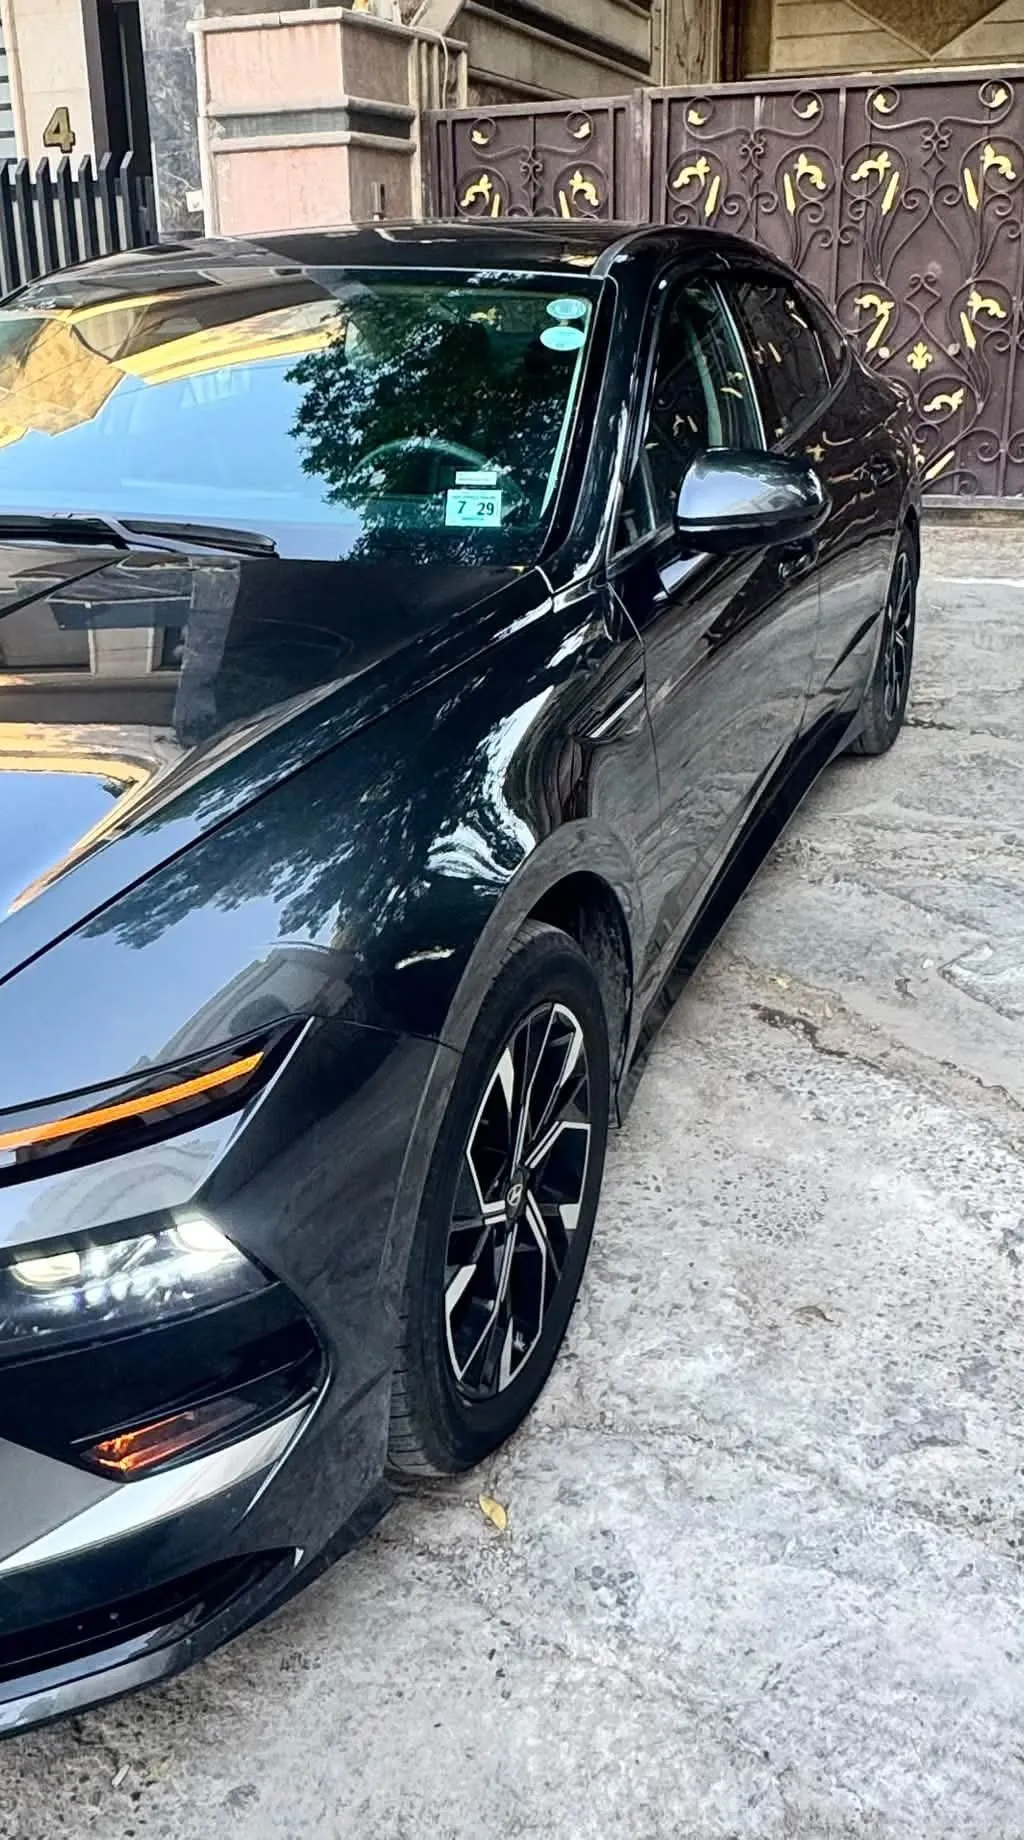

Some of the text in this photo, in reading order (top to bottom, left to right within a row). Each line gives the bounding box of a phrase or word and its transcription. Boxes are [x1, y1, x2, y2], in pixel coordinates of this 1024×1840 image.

[43, 107, 76, 154] 4
[457, 500, 495, 516] 7 29
